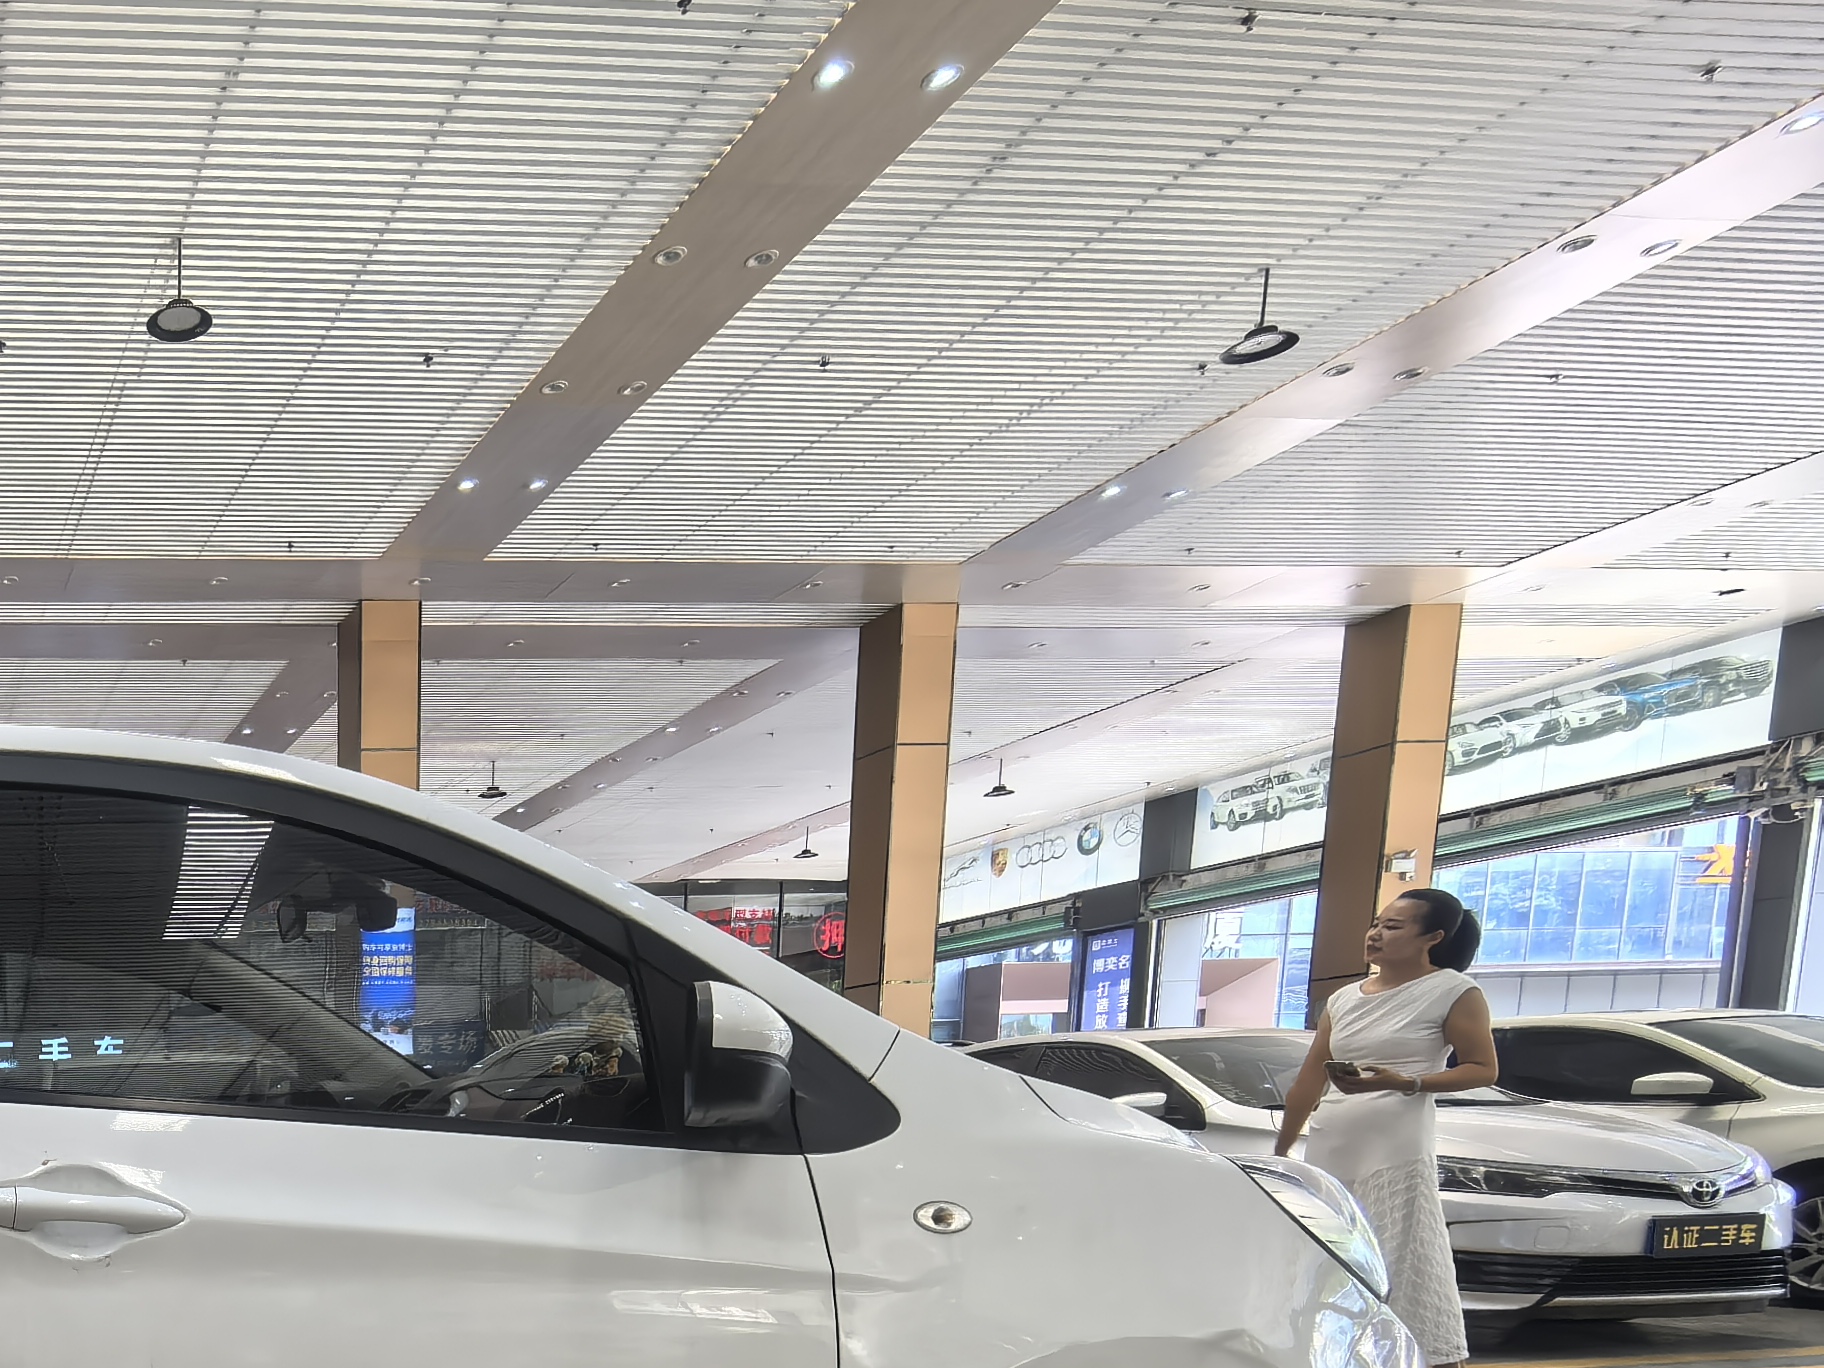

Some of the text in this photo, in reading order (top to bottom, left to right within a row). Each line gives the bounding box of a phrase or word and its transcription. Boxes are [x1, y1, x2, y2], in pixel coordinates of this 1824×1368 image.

[1663, 1224, 1758, 1249] 认证二手车
